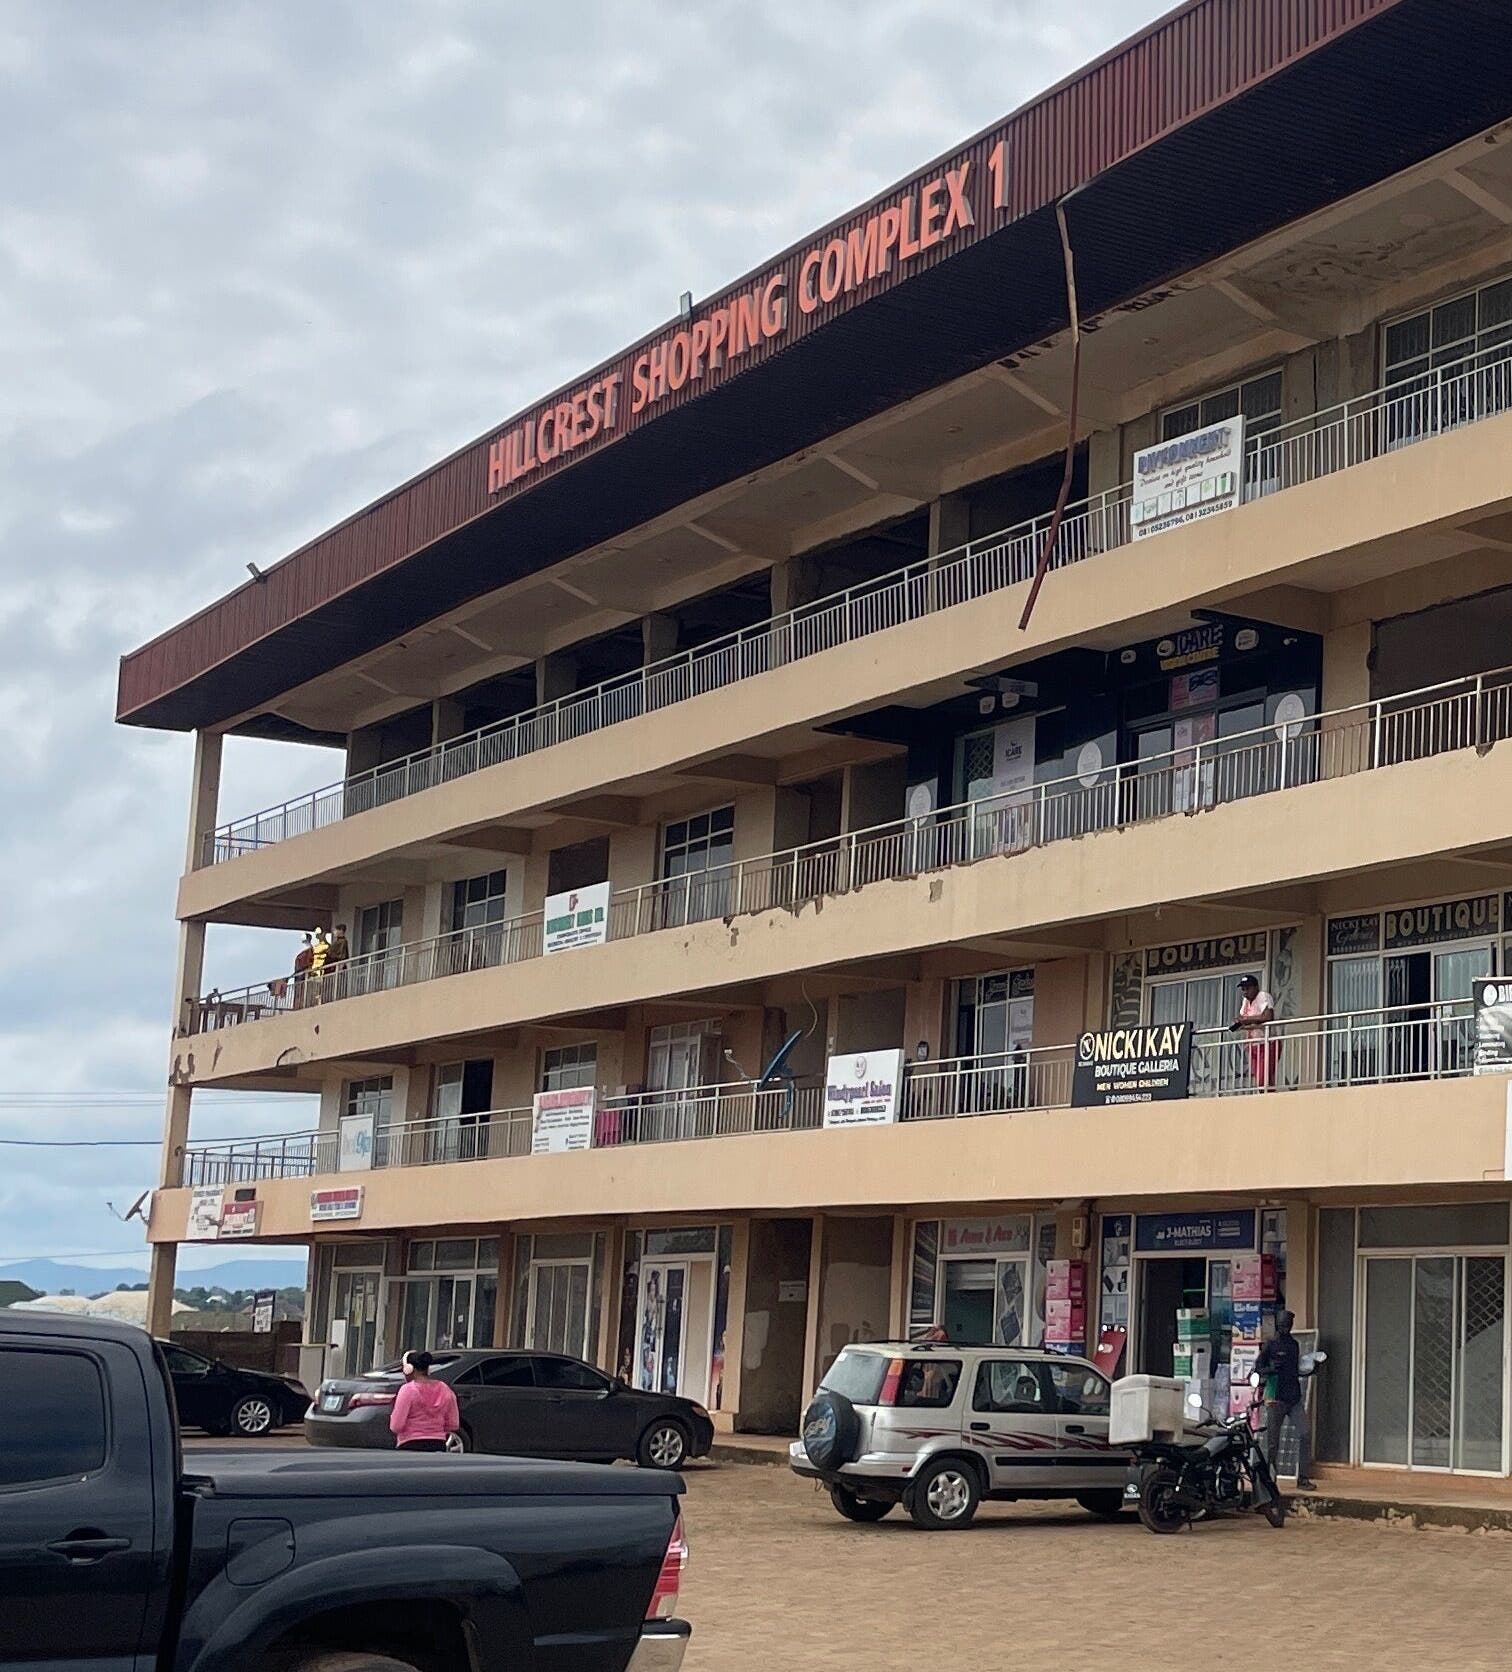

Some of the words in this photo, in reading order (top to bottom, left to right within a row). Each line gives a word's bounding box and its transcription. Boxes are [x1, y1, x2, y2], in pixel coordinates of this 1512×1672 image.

[488, 373, 622, 494] HILLCREST
[631, 273, 788, 414] SHOPPING
[799, 161, 975, 314] COMPLEX
[987, 140, 1010, 210] 1
[1386, 898, 1499, 941] BOUTIQUE
[1149, 934, 1265, 968] BOUTIQUE
[1094, 1028, 1142, 1062] NICKI
[1146, 1024, 1185, 1058] KAY
[1095, 1061, 1137, 1079] BOUTIQUE
[1138, 1058, 1179, 1075] GALLERIA
[1097, 1080, 1111, 1091] MEN
[1113, 1079, 1138, 1090] WOMEN
